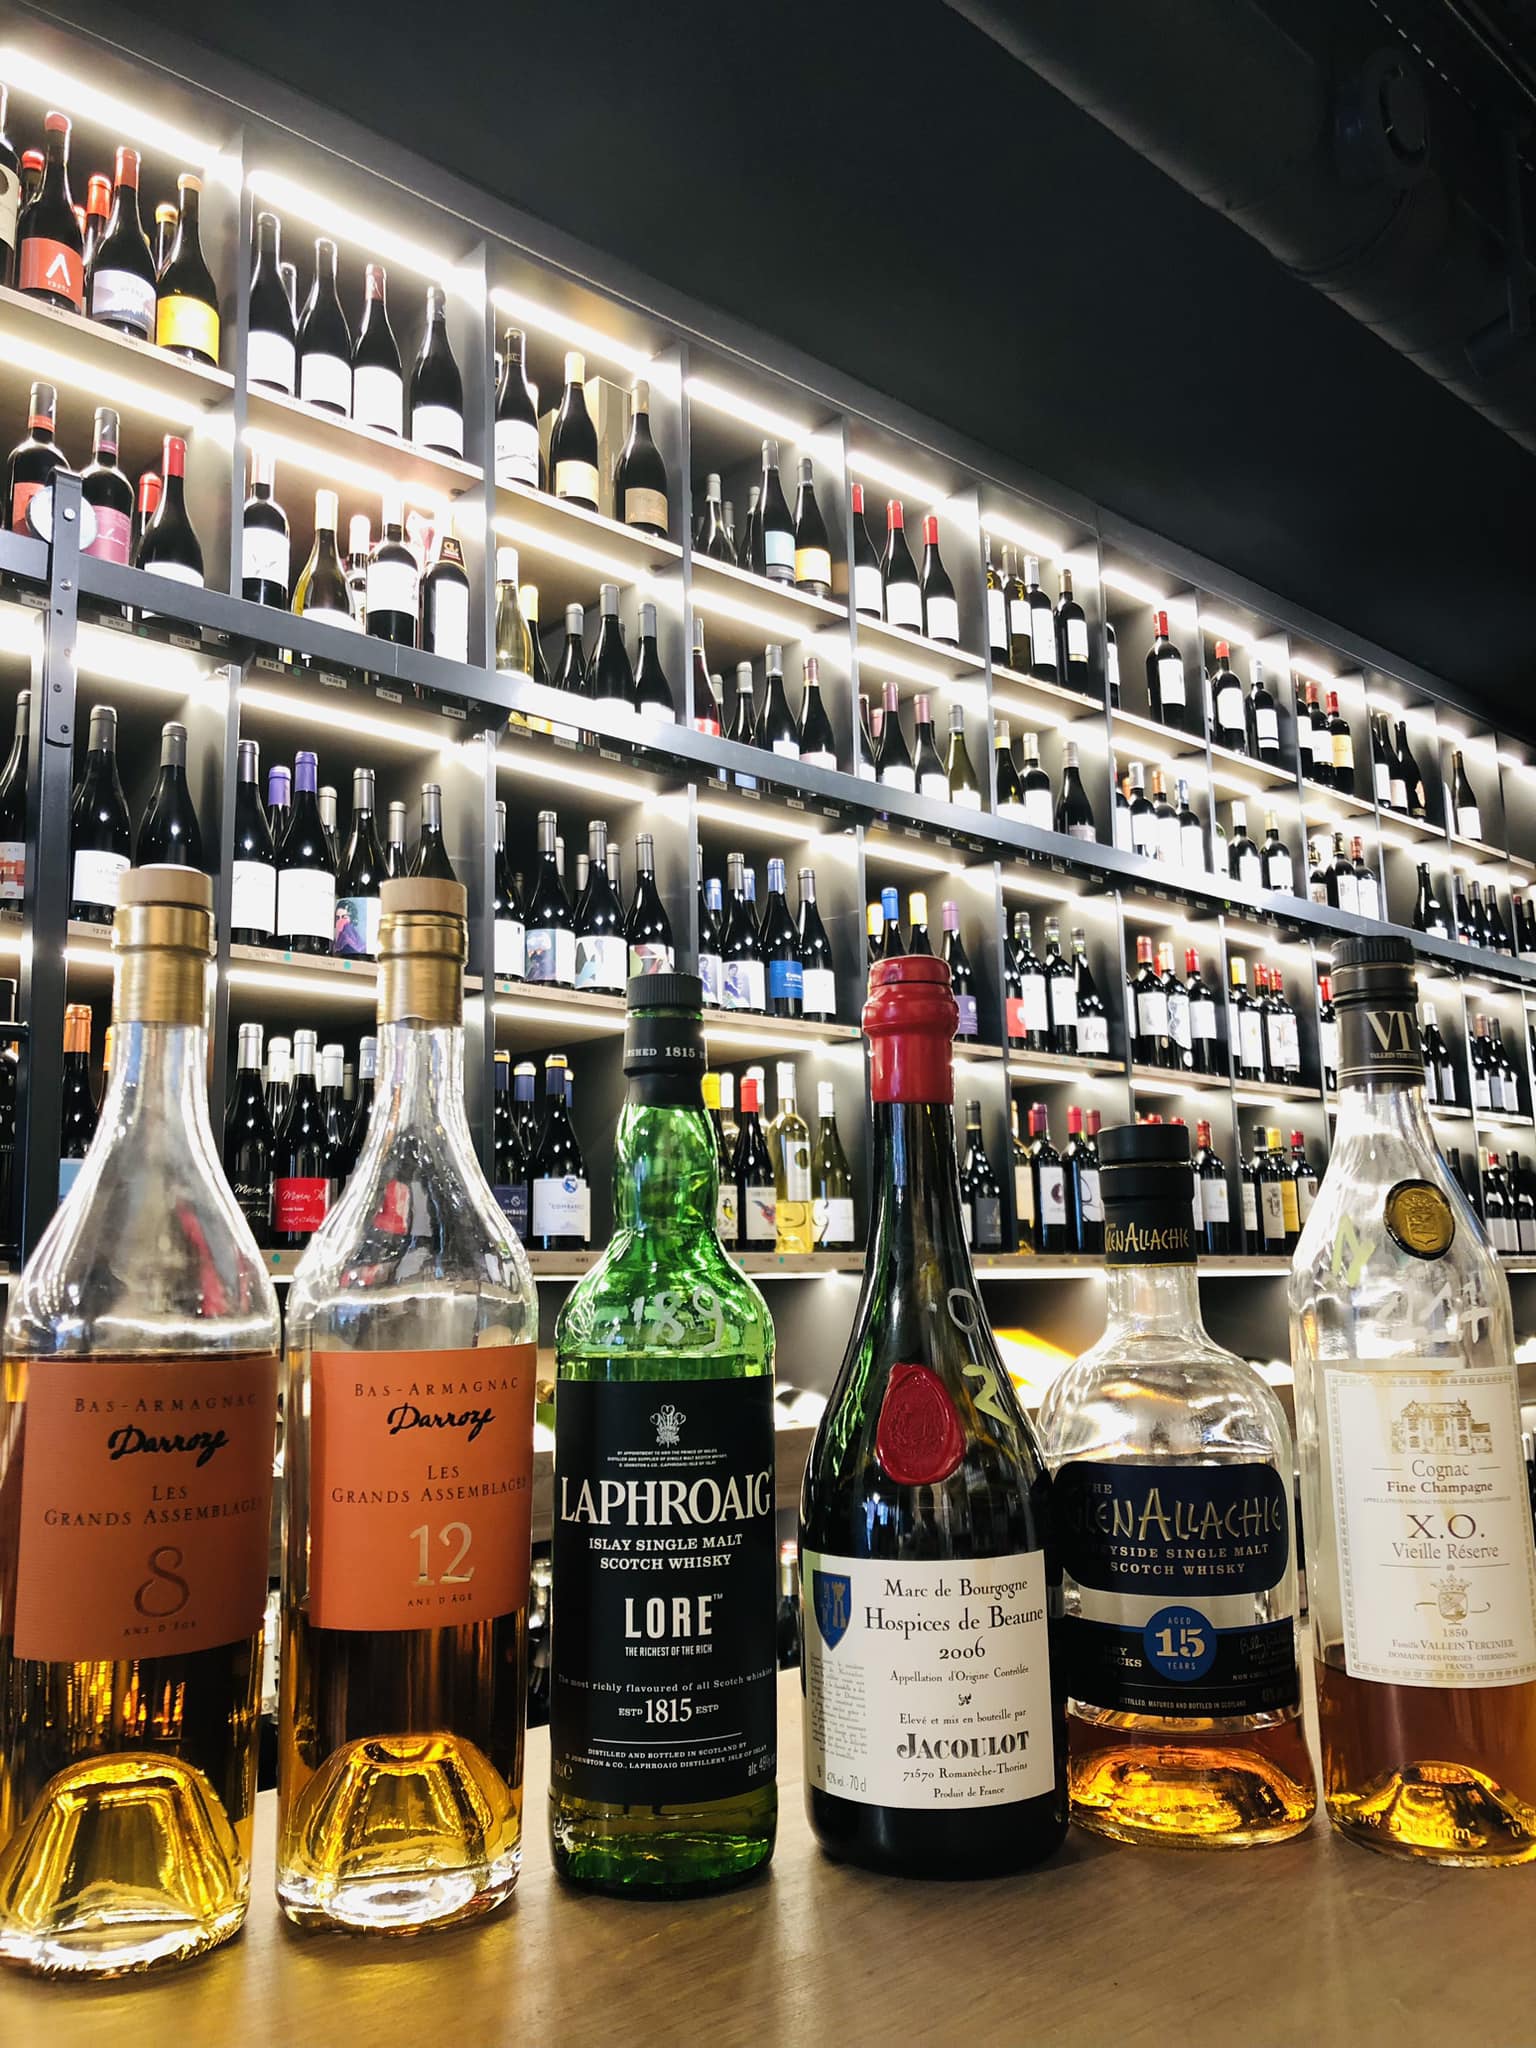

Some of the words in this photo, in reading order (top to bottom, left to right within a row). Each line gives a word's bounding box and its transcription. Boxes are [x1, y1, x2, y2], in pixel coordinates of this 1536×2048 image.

[664, 1046, 696, 1058] 1815
[354, 1377, 520, 1398] BAS-ARMAGNAC
[74, 1394, 257, 1413] BAS-ARMAGNAC
[387, 1402, 497, 1442] Darroze
[107, 1423, 230, 1468] Darroze
[427, 1465, 460, 1481] LES
[1411, 1460, 1470, 1482] Cognac
[152, 1485, 189, 1502] LES
[332, 1487, 411, 1504] GRANDS
[1386, 1481, 1417, 1493] Fine
[1420, 1480, 1493, 1496] Champagne
[560, 1471, 771, 1526] LAPHROAIG
[44, 1508, 132, 1527] GRANDS
[1406, 1513, 1486, 1540] X.O.
[588, 1537, 632, 1551] ISLAY
[635, 1537, 698, 1551] SINGLE
[702, 1533, 743, 1549] MALT
[1166, 1547, 1228, 1559] SINGLE
[1234, 1543, 1270, 1557] MALT
[1392, 1542, 1441, 1560] Vieille
[1447, 1541, 1500, 1560] Réserve
[407, 1521, 475, 1588] 12
[599, 1557, 664, 1570] SCOTCH
[667, 1553, 732, 1570] WHISKY
[1110, 1561, 1175, 1575] SCOTCH
[1182, 1562, 1246, 1576] WHISKY
[883, 1578, 928, 1598] Marc
[934, 1578, 952, 1598] de
[959, 1577, 1029, 1601] Bourgogne
[864, 1605, 951, 1641] Hospices
[958, 1607, 981, 1631] de
[987, 1604, 1045, 1630] Beaune
[1167, 1616, 1192, 1626] AGED
[625, 1646, 638, 1657] THE
[639, 1645, 669, 1657] RICHEST
[671, 1645, 681, 1656] OF
[682, 1644, 695, 1656] THE
[695, 1643, 713, 1655] RICH
[938, 1635, 986, 1660] 2006
[1154, 1627, 1206, 1658] 15
[1167, 1661, 1196, 1671] YEARS
[592, 1681, 622, 1694] richly
[626, 1683, 678, 1693] flavoured
[682, 1682, 694, 1692] of
[696, 1681, 710, 1691] all
[713, 1675, 744, 1689] Scotch
[889, 1669, 943, 1685] Appellation
[948, 1669, 990, 1685] d'Origine
[645, 1697, 693, 1724] 1815
[899, 1713, 928, 1725] Elevé
[930, 1717, 940, 1725] et
[943, 1715, 960, 1725] mis
[962, 1716, 974, 1724] en
[976, 1708, 1013, 1723] bouteille
[1014, 1709, 1028, 1722] par
[587, 1748, 626, 1759] DISTILLED
[647, 1751, 686, 1759] BOTTLED
[698, 1743, 738, 1756] SCOTLAND
[896, 1730, 1030, 1760] JACOULOT
[629, 1761, 679, 1769] LAPHROAIG
[743, 1750, 752, 1758] OF
[903, 1769, 935, 1784] 71570
[933, 1788, 965, 1799] Produit
[967, 1786, 978, 1797] de
[978, 1785, 1006, 1797] France
